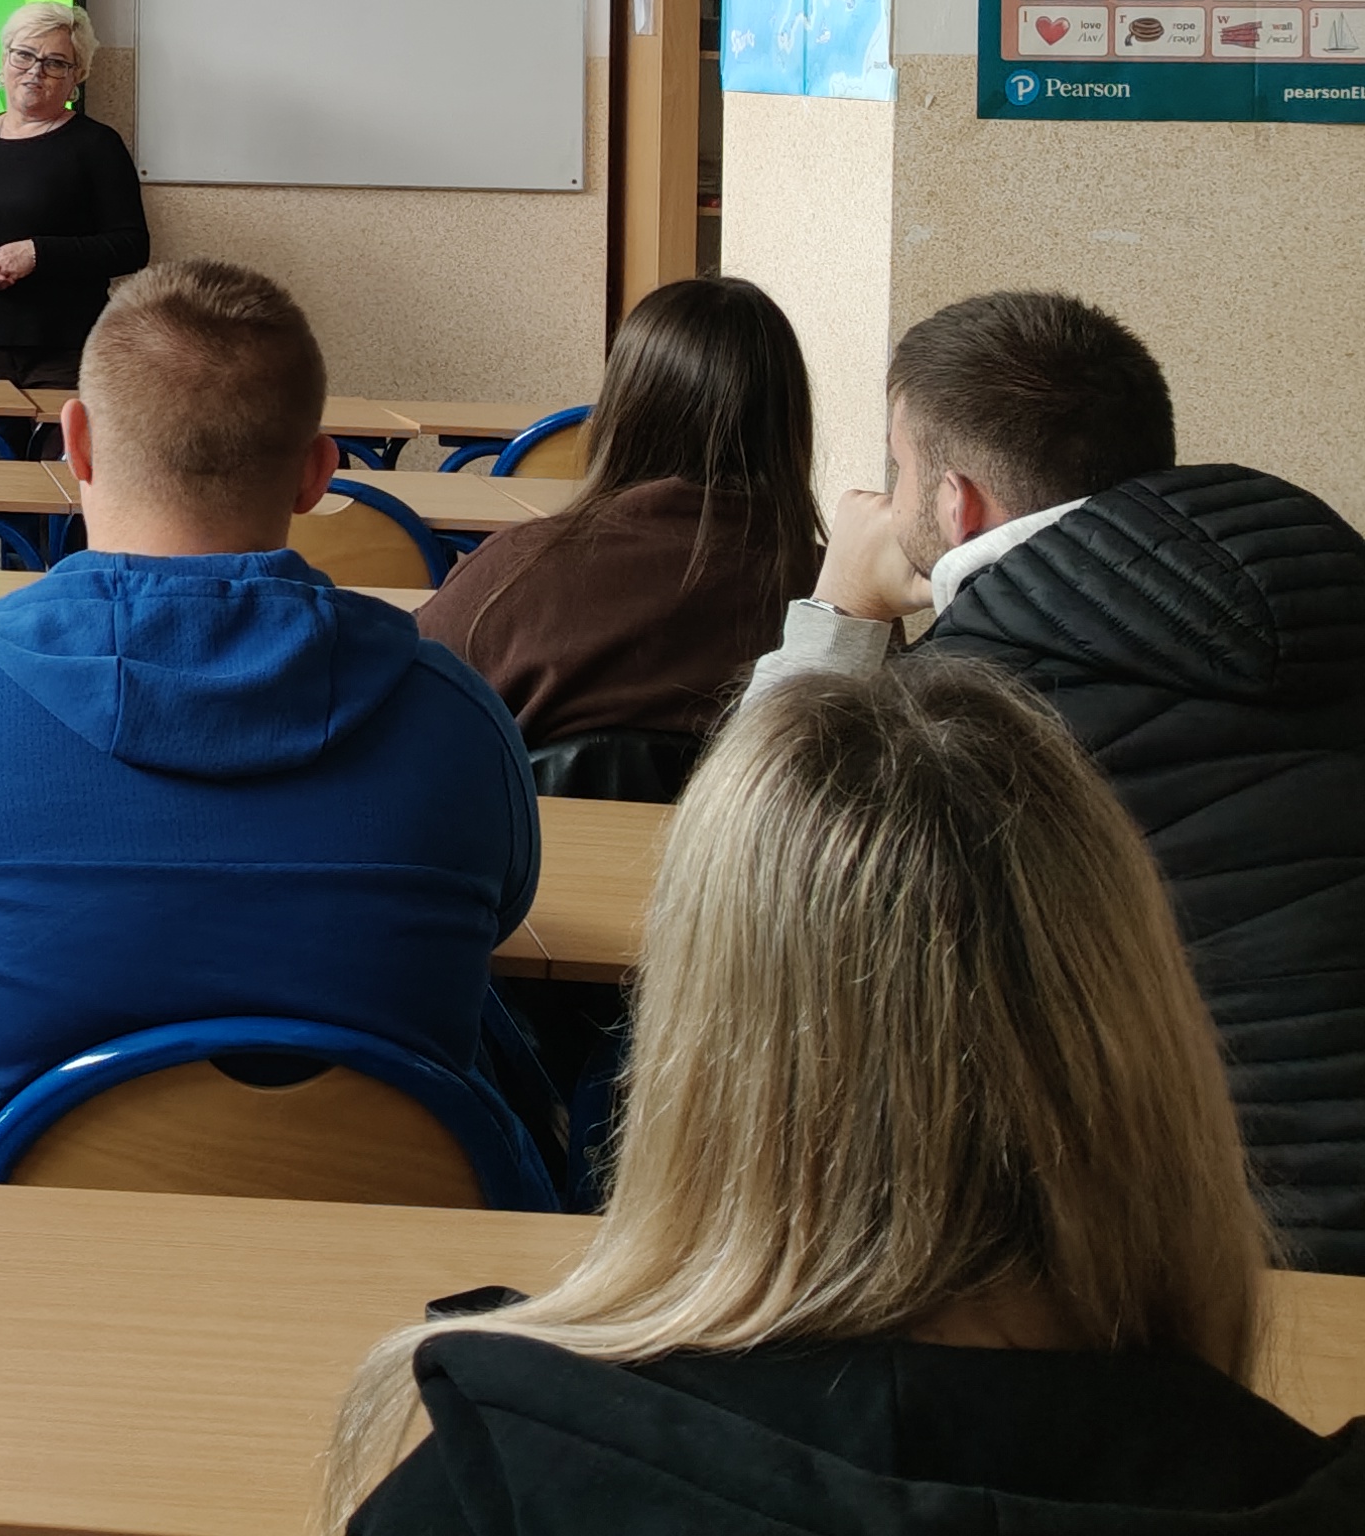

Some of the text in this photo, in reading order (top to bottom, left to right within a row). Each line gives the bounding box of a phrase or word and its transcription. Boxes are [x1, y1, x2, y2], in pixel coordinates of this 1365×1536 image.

[1080, 21, 1102, 30] love
[1173, 22, 1196, 31] rope
[1045, 78, 1131, 98] Pearson
